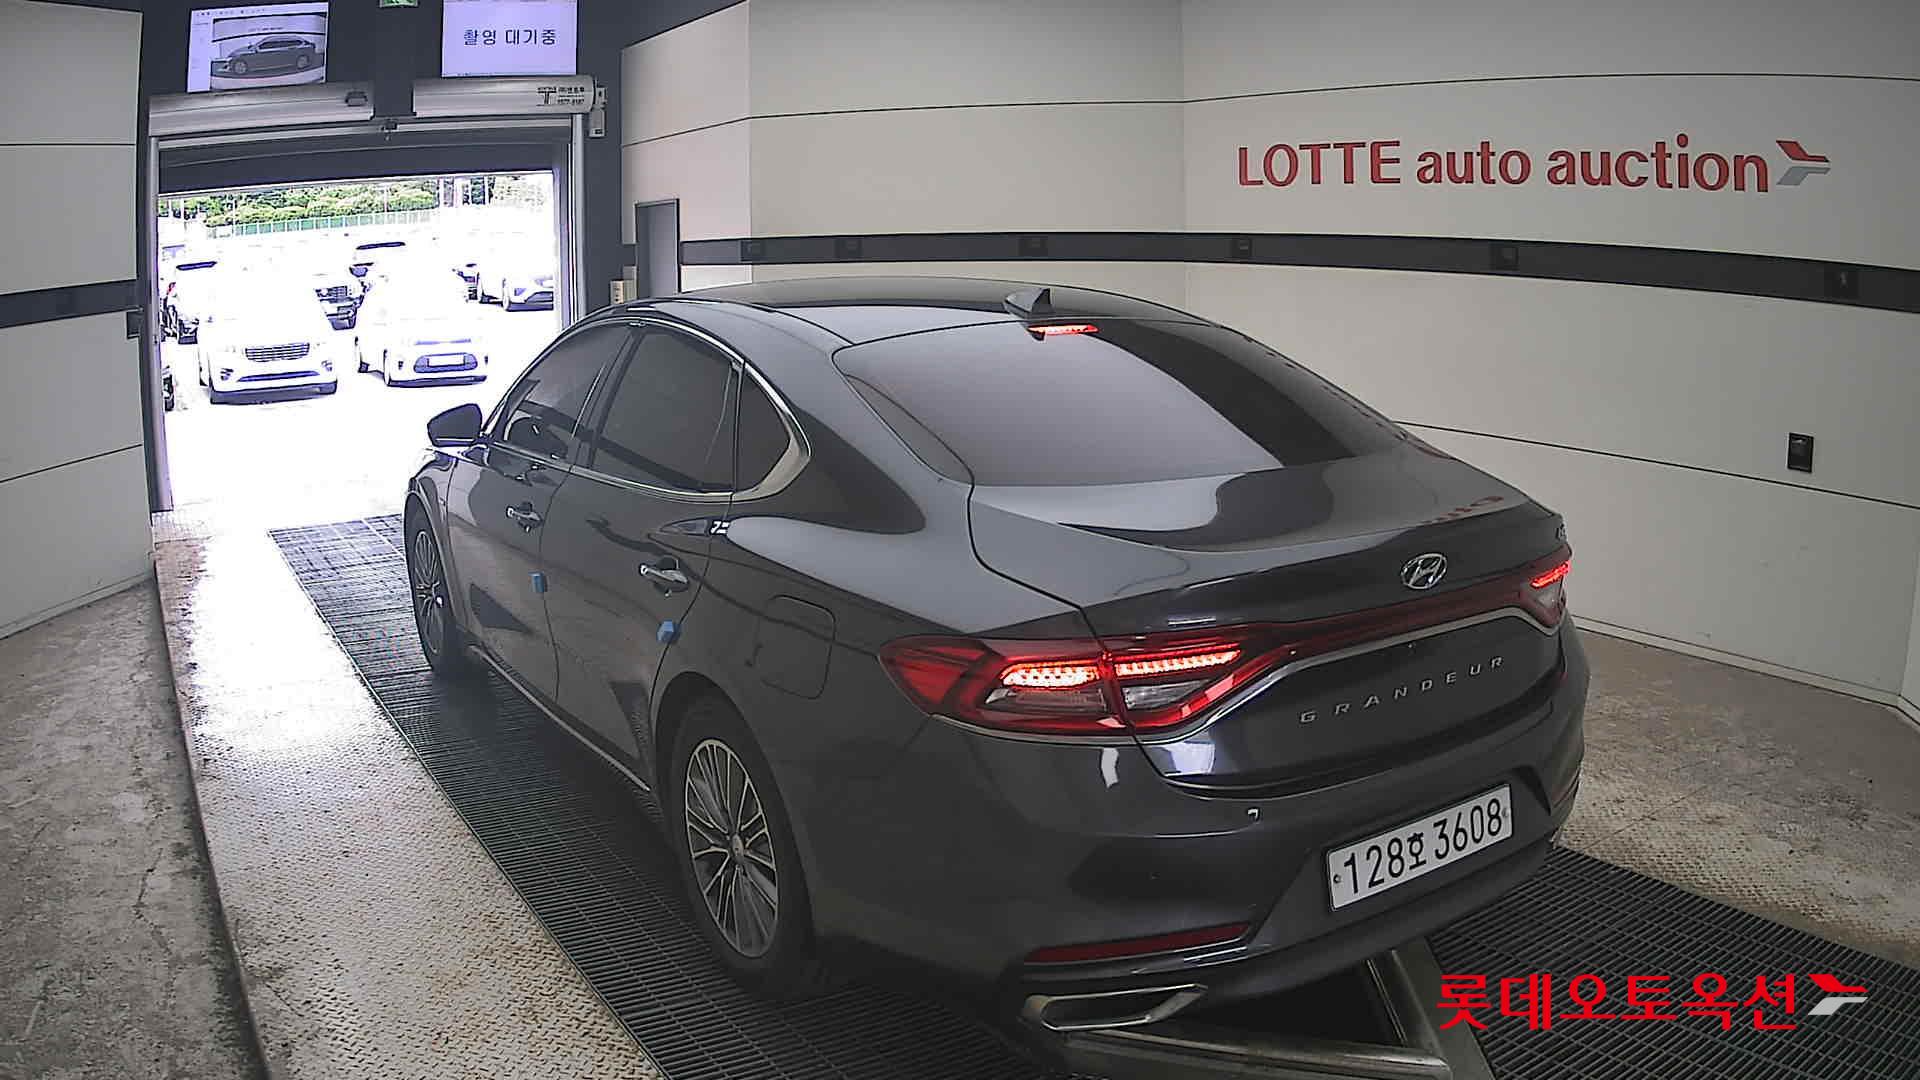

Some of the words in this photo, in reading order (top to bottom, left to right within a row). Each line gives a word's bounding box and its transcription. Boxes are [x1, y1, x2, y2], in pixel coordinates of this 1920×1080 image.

[463, 29, 497, 46] 촬영
[505, 29, 556, 45] 대기중
[1239, 141, 1401, 187] LOTTE
[1416, 141, 1532, 186] auto
[1546, 133, 1769, 193] auction
[1299, 655, 1503, 723] GRANDEUR
